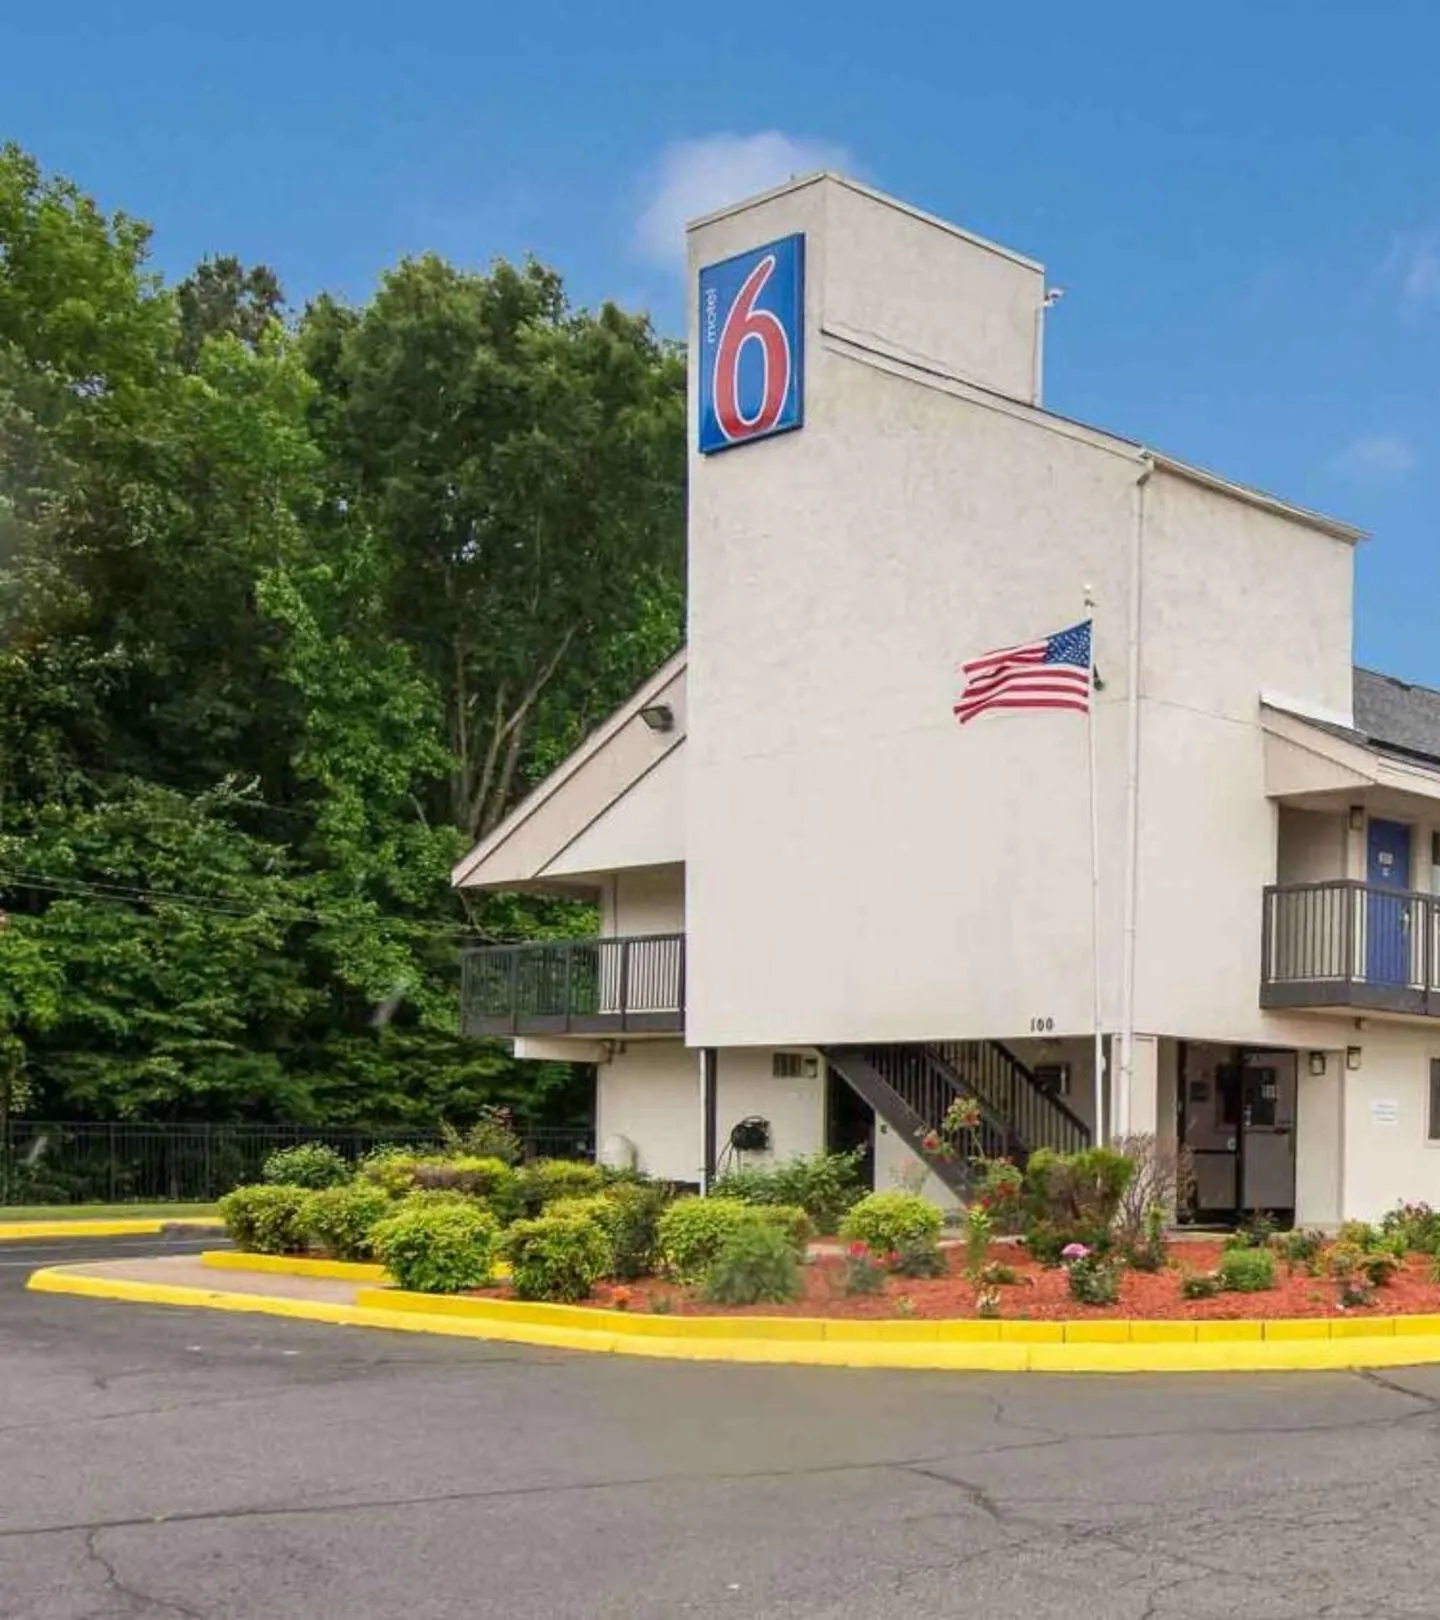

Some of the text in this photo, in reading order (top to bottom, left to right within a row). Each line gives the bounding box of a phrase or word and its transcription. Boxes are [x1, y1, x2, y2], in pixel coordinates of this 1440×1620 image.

[706, 287, 718, 344] motel
[713, 254, 791, 442] 6
[1030, 1017, 1054, 1033] 100
